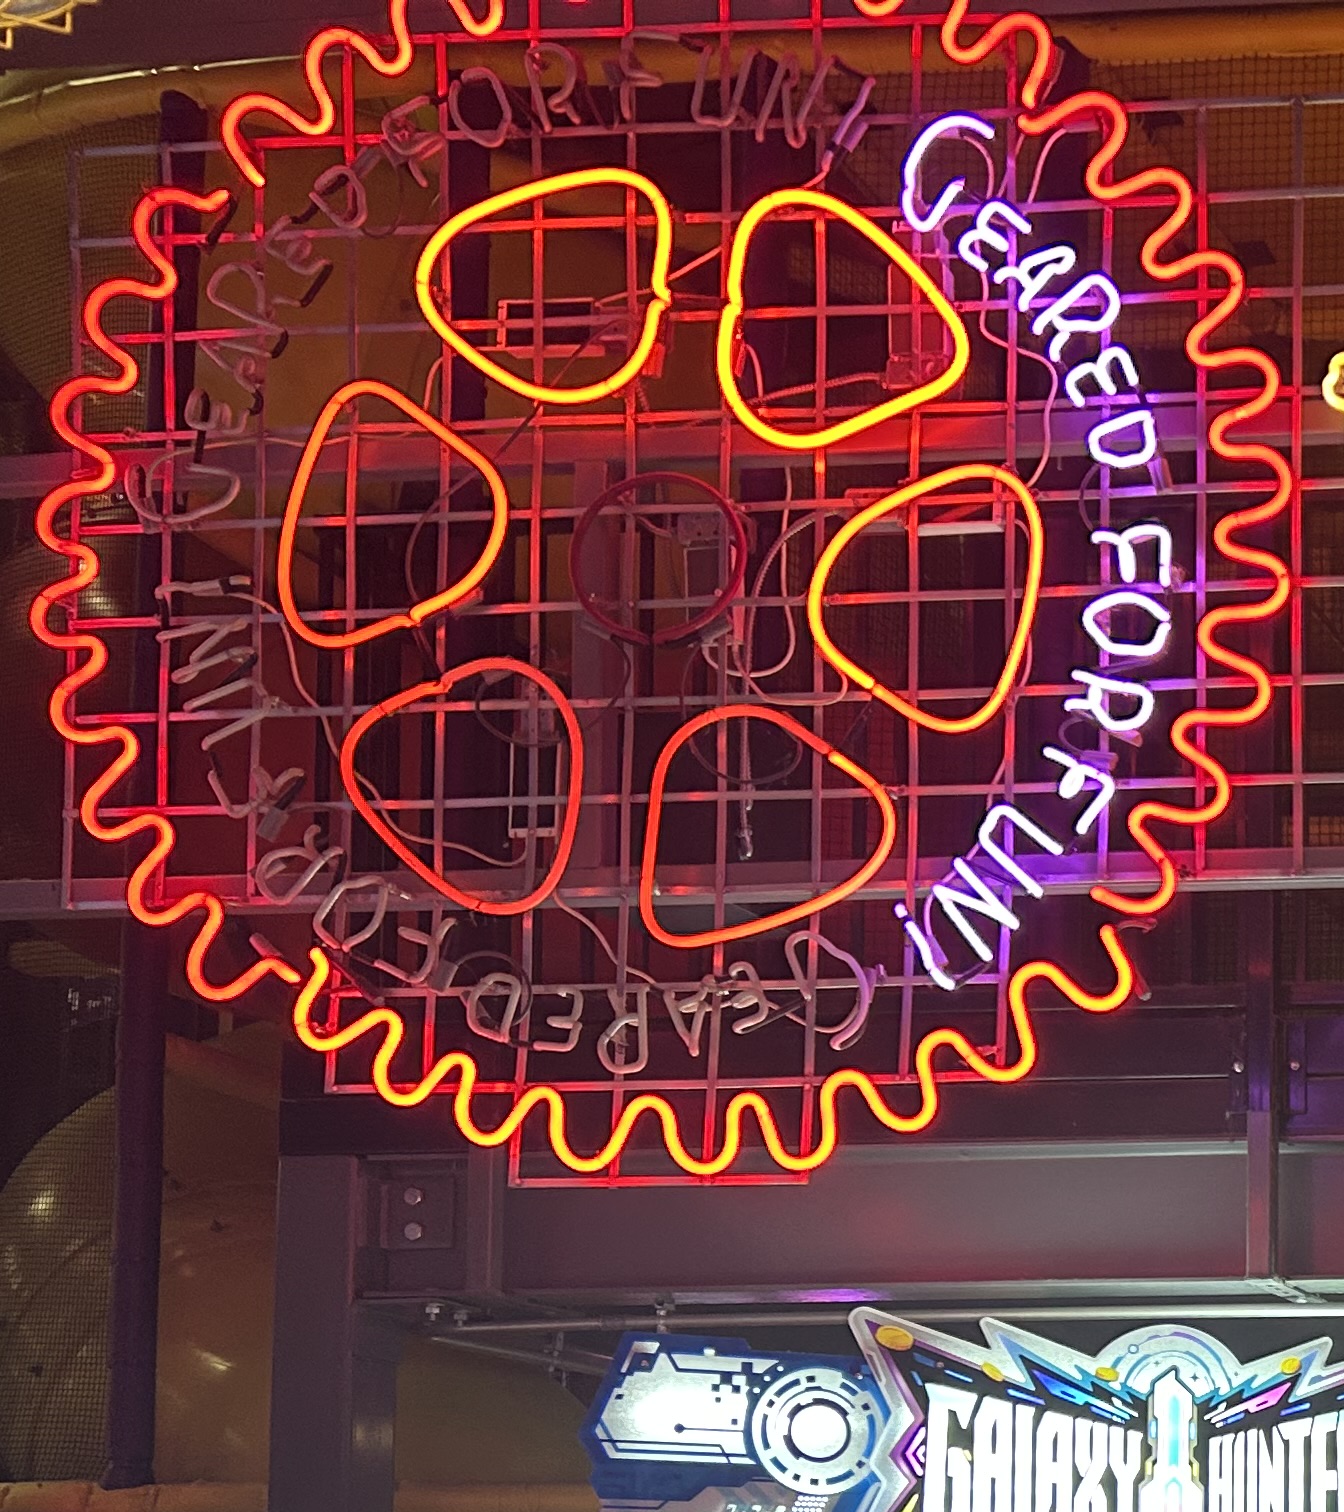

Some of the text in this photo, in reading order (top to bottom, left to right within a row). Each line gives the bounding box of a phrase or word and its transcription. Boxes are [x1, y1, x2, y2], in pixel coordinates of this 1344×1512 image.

[893, 108, 1173, 992] GEARED FOR FUN!
